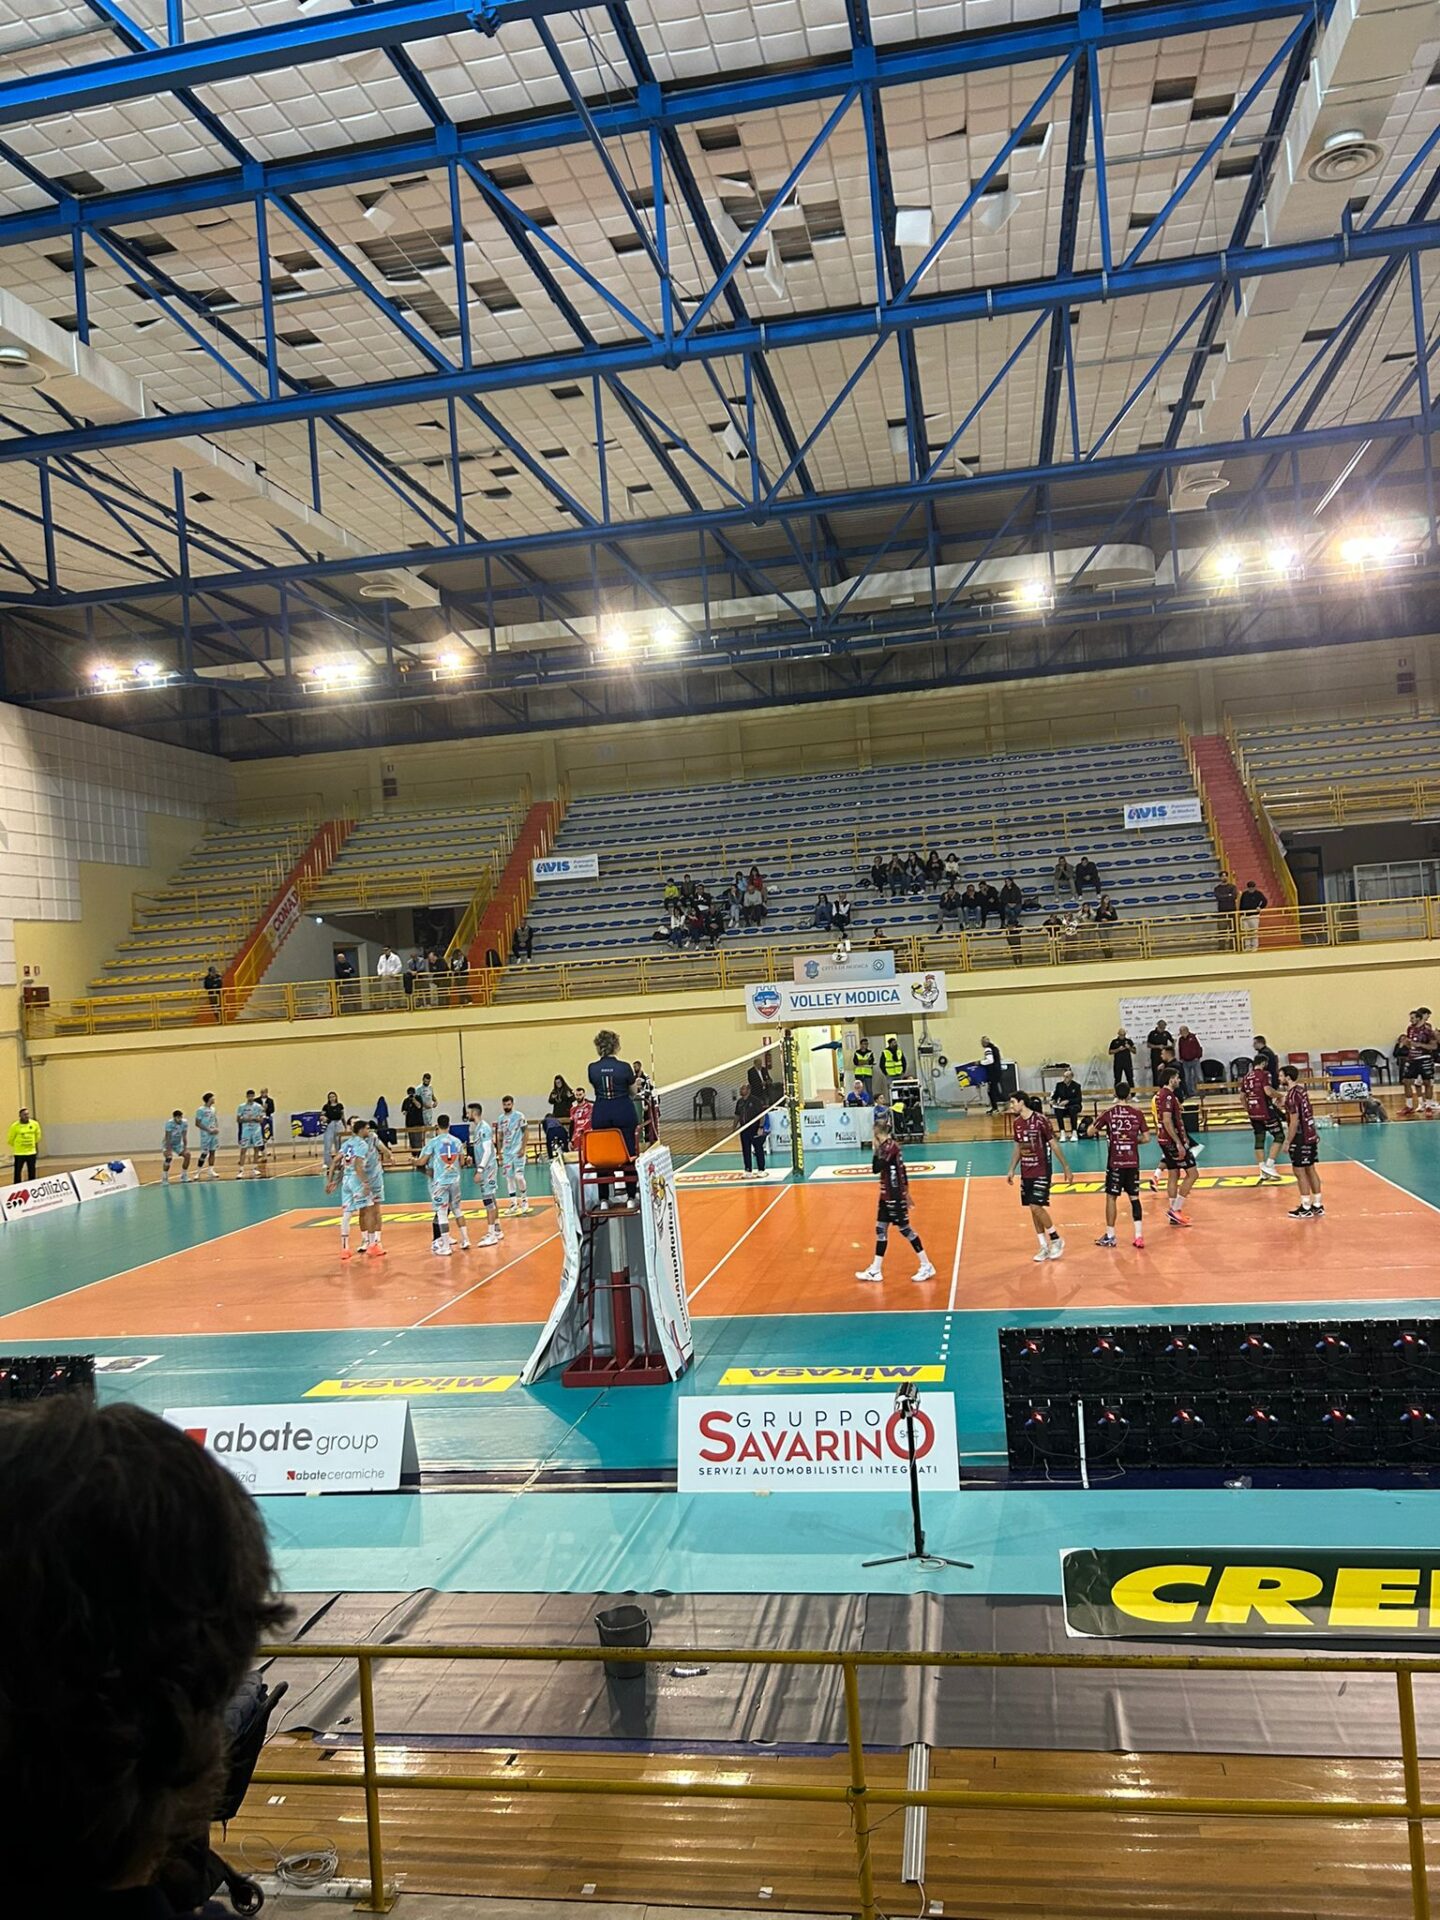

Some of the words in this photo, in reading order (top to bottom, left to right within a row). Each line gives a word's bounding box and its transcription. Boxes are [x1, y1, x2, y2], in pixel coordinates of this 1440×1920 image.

[1127, 806, 1168, 820] AVIS
[536, 861, 571, 873] AVIS
[790, 992, 842, 1008] VOLLEY
[846, 989, 901, 1004] MODICA
[1117, 1119, 1132, 1131] 23
[31, 1179, 71, 1199] edilizia
[736, 1409, 881, 1428] GRUPPO
[213, 1422, 313, 1454] abate
[315, 1431, 379, 1456] group
[698, 1408, 936, 1463] SAVARINO
[698, 1466, 747, 1476] SERVIZI
[752, 1465, 864, 1475] AUTOMOBILISTICI
[870, 1465, 938, 1475] INTEGATI
[1110, 1564, 1440, 1628] CRE
